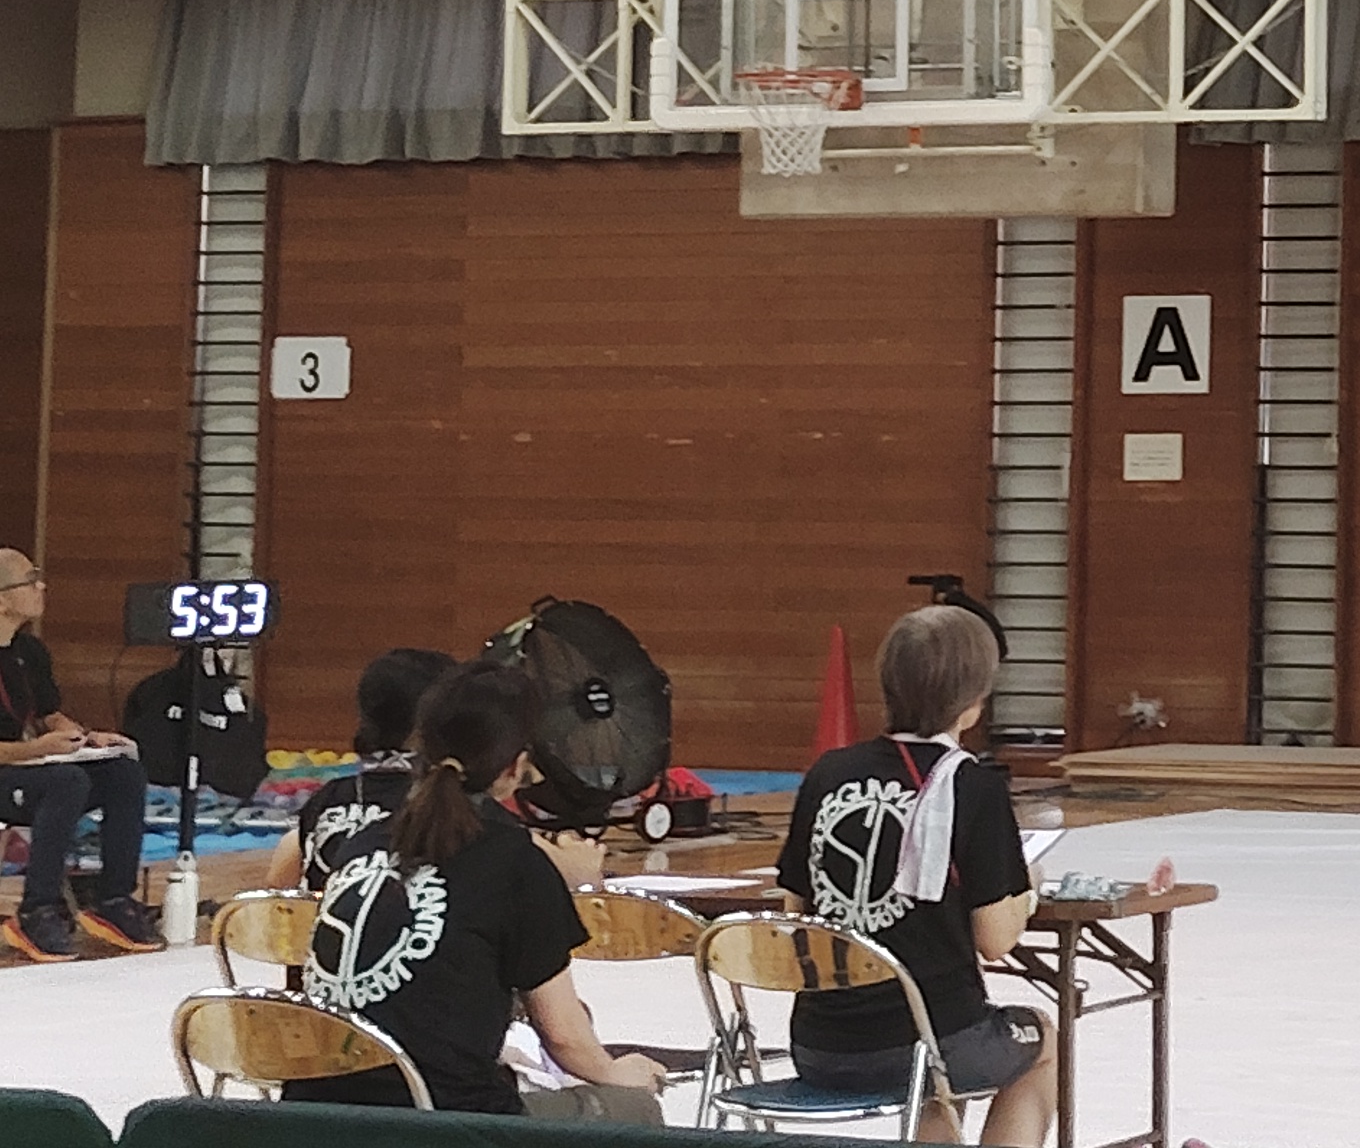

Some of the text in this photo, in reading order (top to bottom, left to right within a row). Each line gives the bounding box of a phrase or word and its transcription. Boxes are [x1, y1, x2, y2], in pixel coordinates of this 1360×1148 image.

[1131, 306, 1201, 383] A
[299, 351, 320, 393] 3
[169, 583, 268, 637] 5:53
